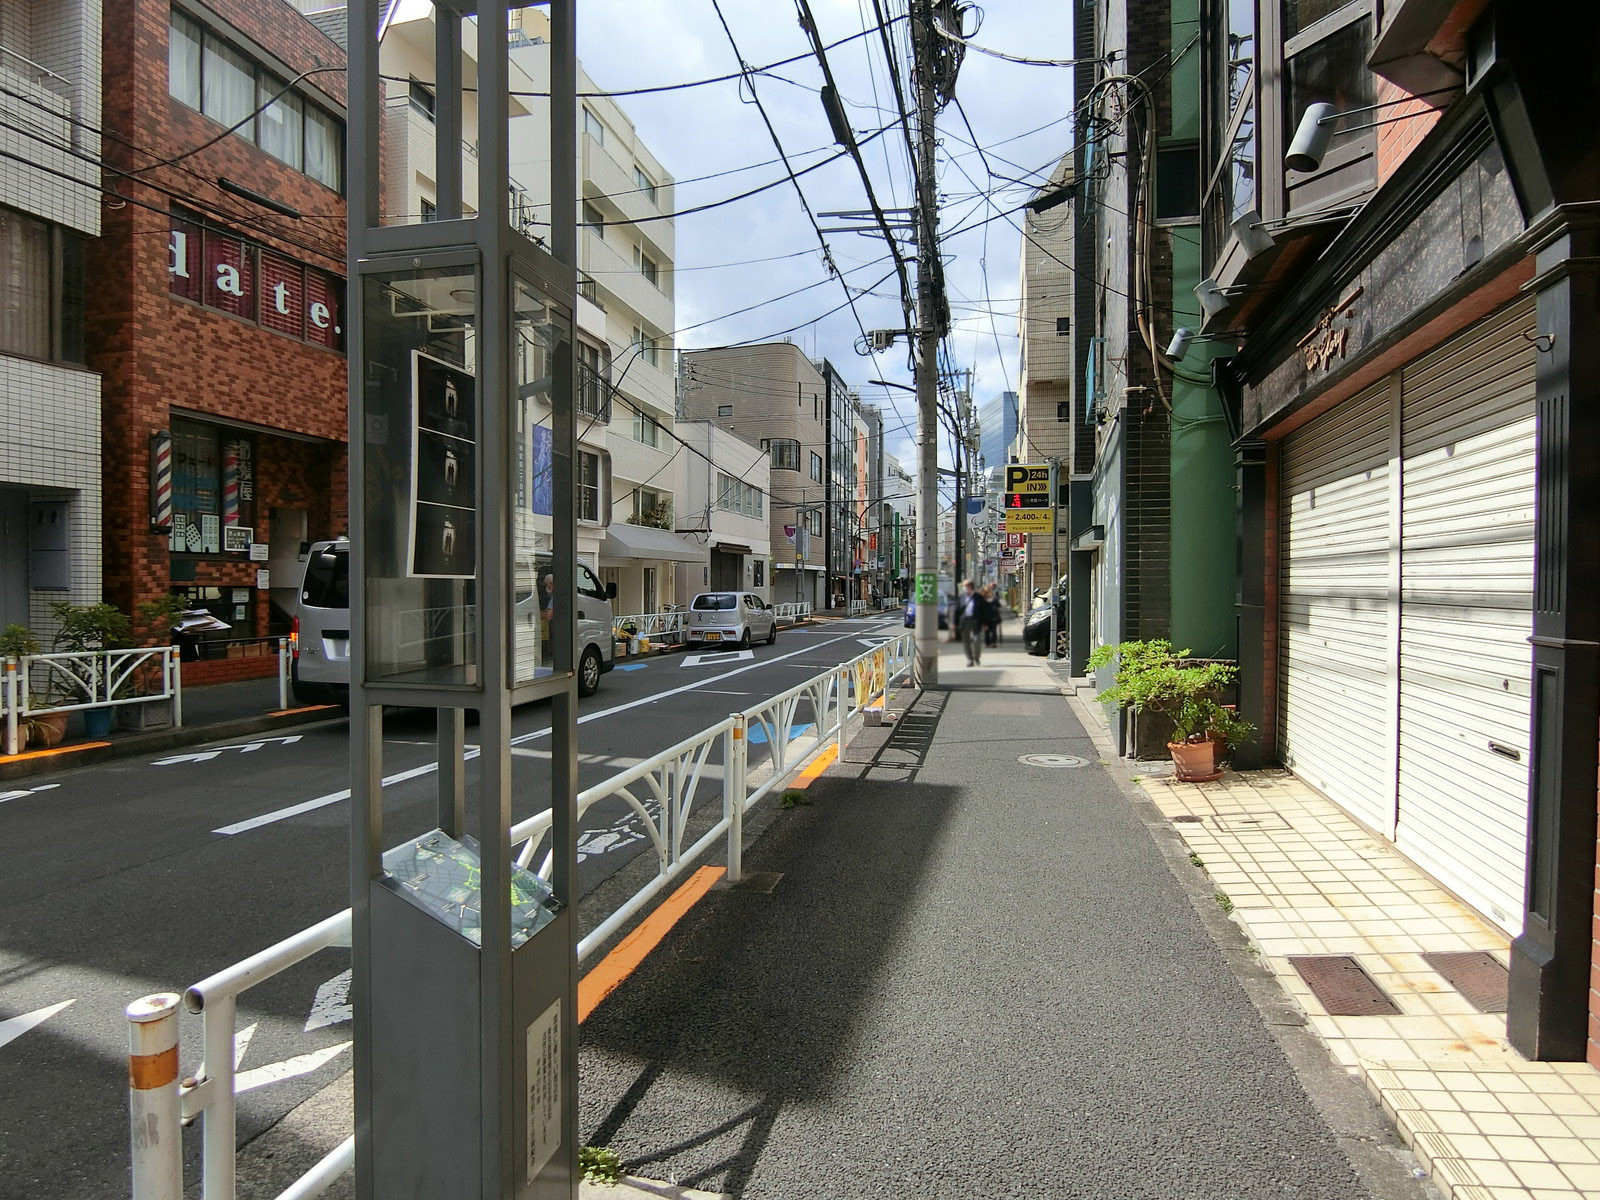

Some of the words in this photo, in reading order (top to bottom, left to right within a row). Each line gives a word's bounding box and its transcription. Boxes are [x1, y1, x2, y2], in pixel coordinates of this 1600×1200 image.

[168, 230, 342, 335] date.
[1007, 467, 1028, 492] P
[1031, 471, 1048, 479] 24h
[1026, 483, 1038, 491] IN
[919, 582, 933, 597] 文
